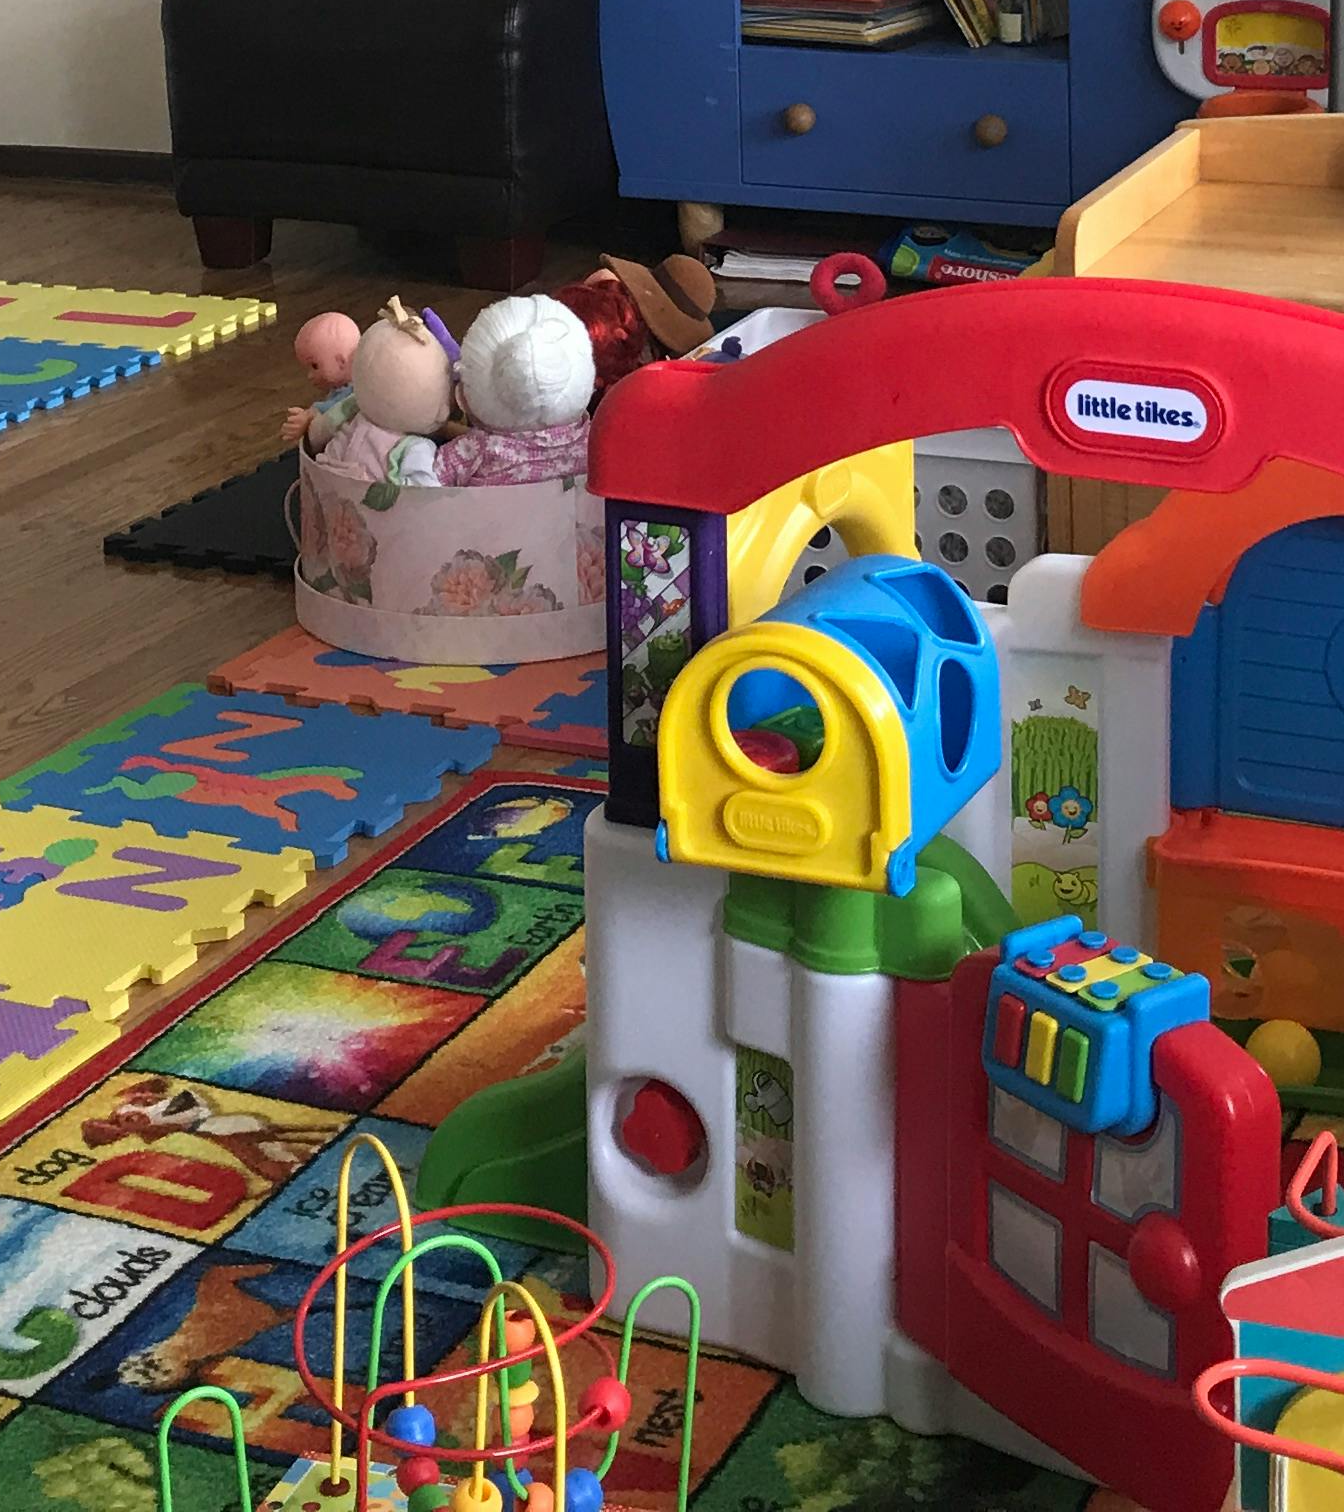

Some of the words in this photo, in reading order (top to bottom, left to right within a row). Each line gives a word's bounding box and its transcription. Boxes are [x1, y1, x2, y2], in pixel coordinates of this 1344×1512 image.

[1077, 392, 1132, 421] little
[1136, 399, 1194, 428] tikes
[12, 1145, 98, 1189] dog
[61, 1148, 250, 1230] D
[72, 1241, 174, 1323] clouds
